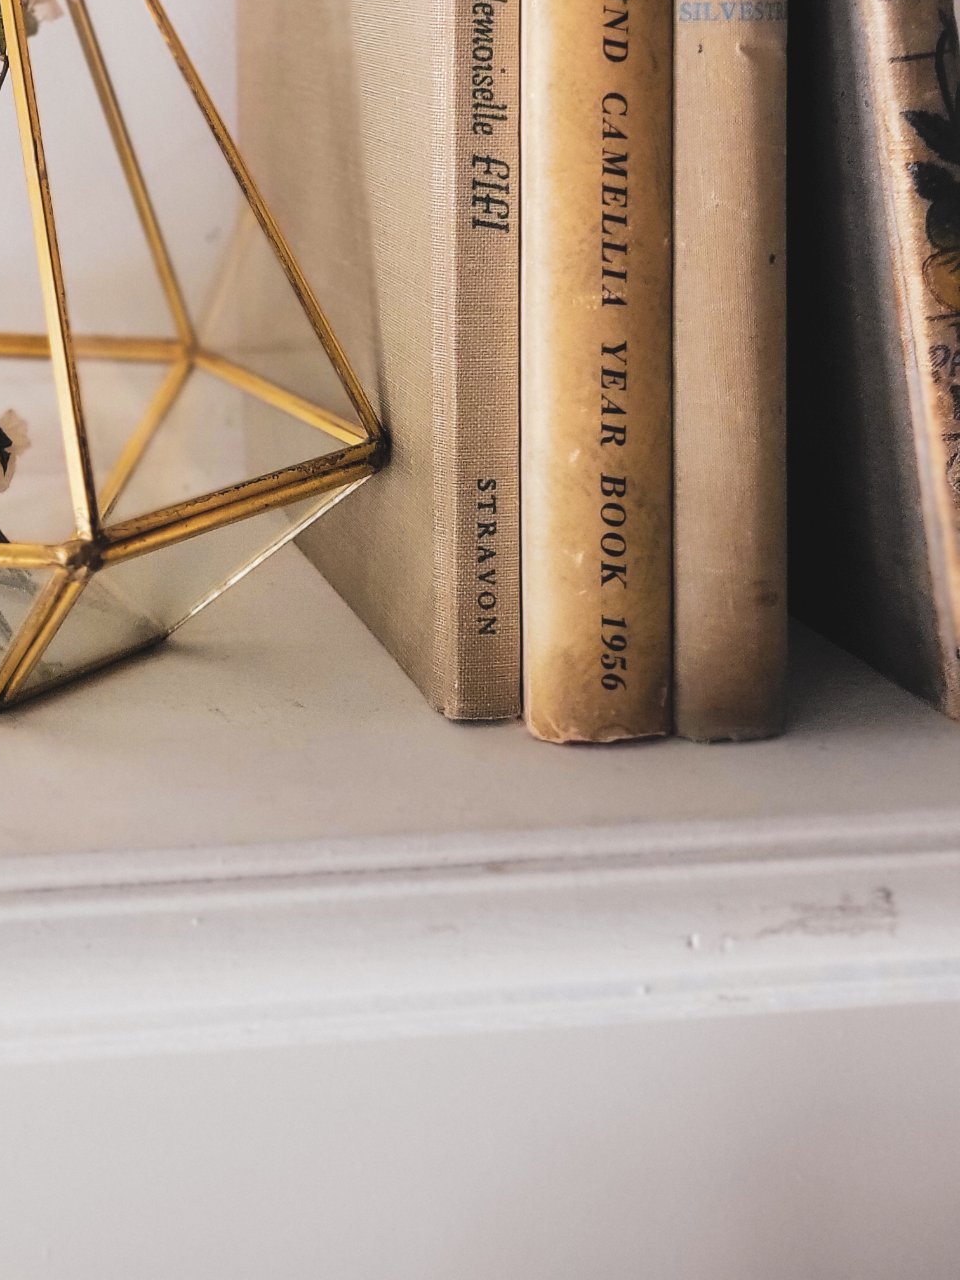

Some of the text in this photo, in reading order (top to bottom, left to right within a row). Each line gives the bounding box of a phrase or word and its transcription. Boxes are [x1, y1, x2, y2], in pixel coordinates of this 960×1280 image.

[679, 0, 788, 21] SILVESTR
[600, 92, 630, 308] CAMELLIA
[600, 340, 629, 448] YEAR
[477, 478, 497, 637] STRAVON
[599, 474, 628, 589] BOOK
[600, 615, 628, 691] 1956
